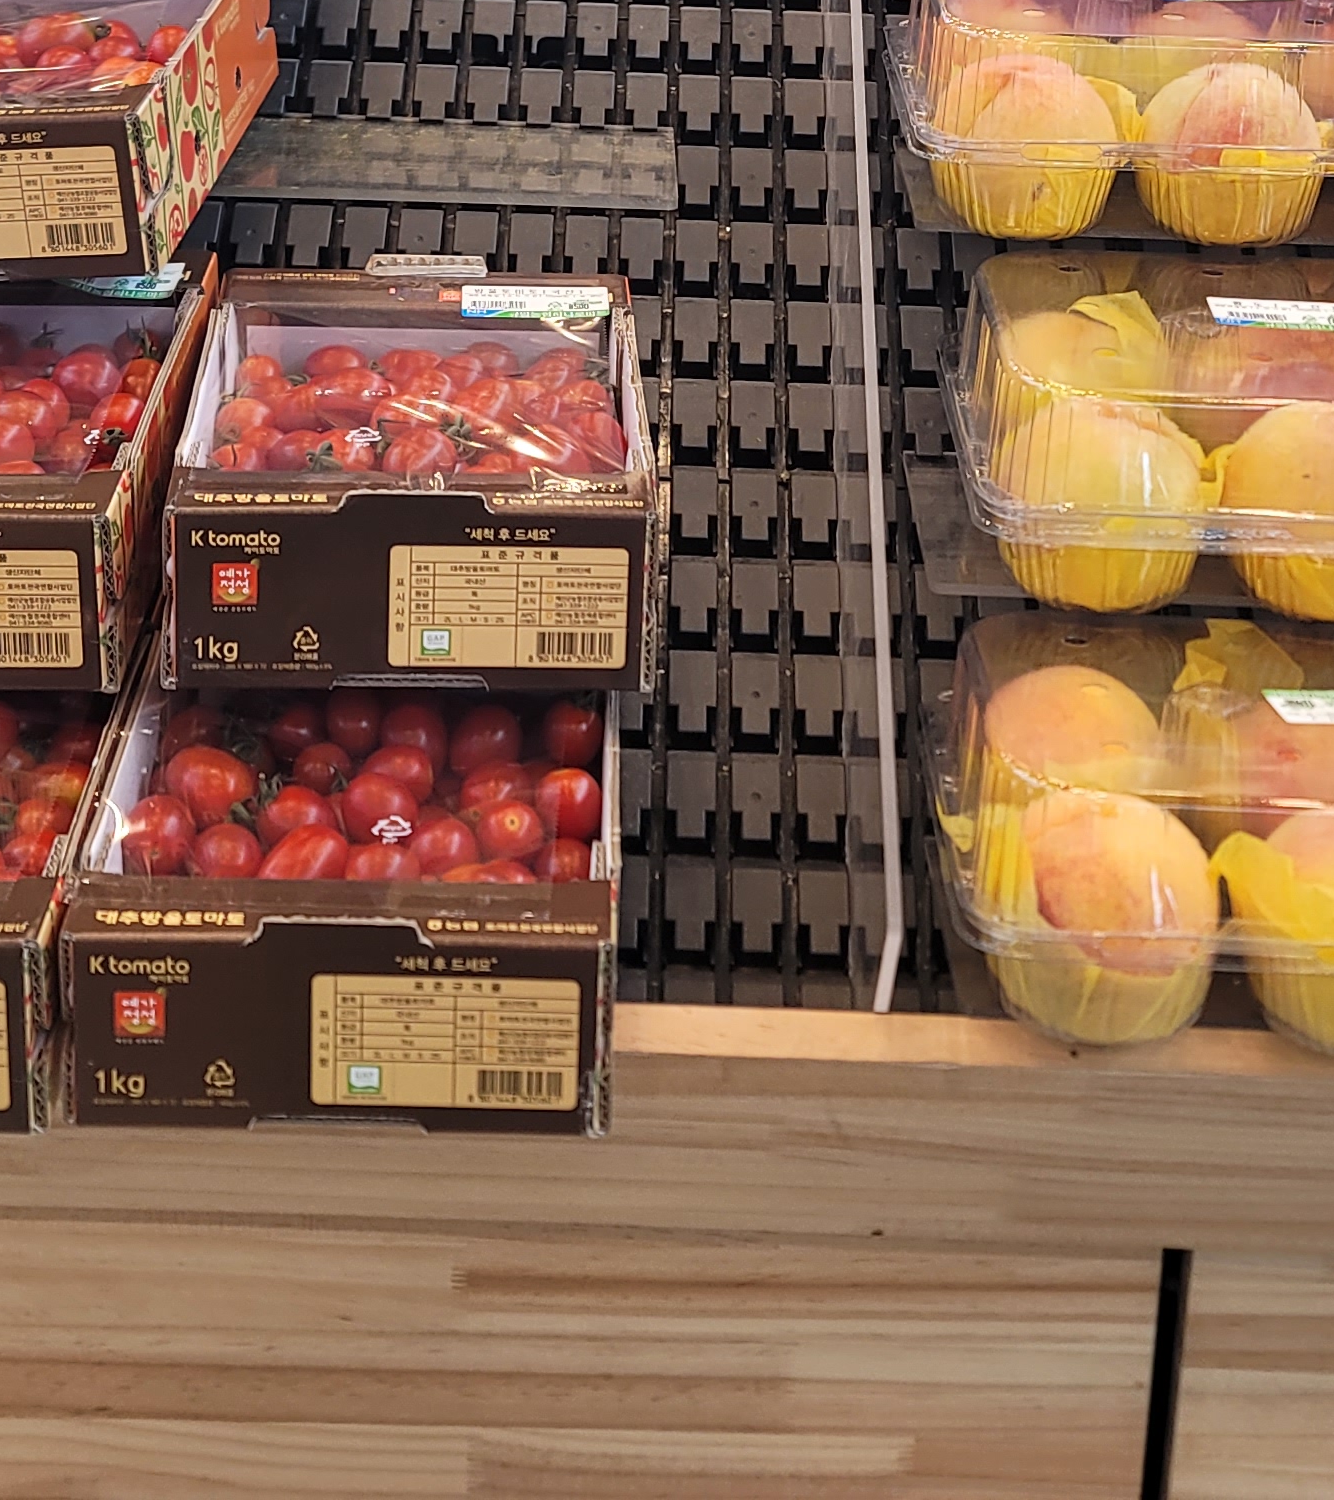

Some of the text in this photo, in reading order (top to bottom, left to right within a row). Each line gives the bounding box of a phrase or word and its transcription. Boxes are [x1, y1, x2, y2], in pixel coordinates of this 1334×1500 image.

[191, 530, 281, 546] K tomato
[498, 528, 511, 541] 후
[194, 636, 239, 662] 1kg
[95, 909, 245, 926] 대추방울토마토
[89, 955, 190, 975] K tomato
[94, 1068, 145, 1098] 1kg
